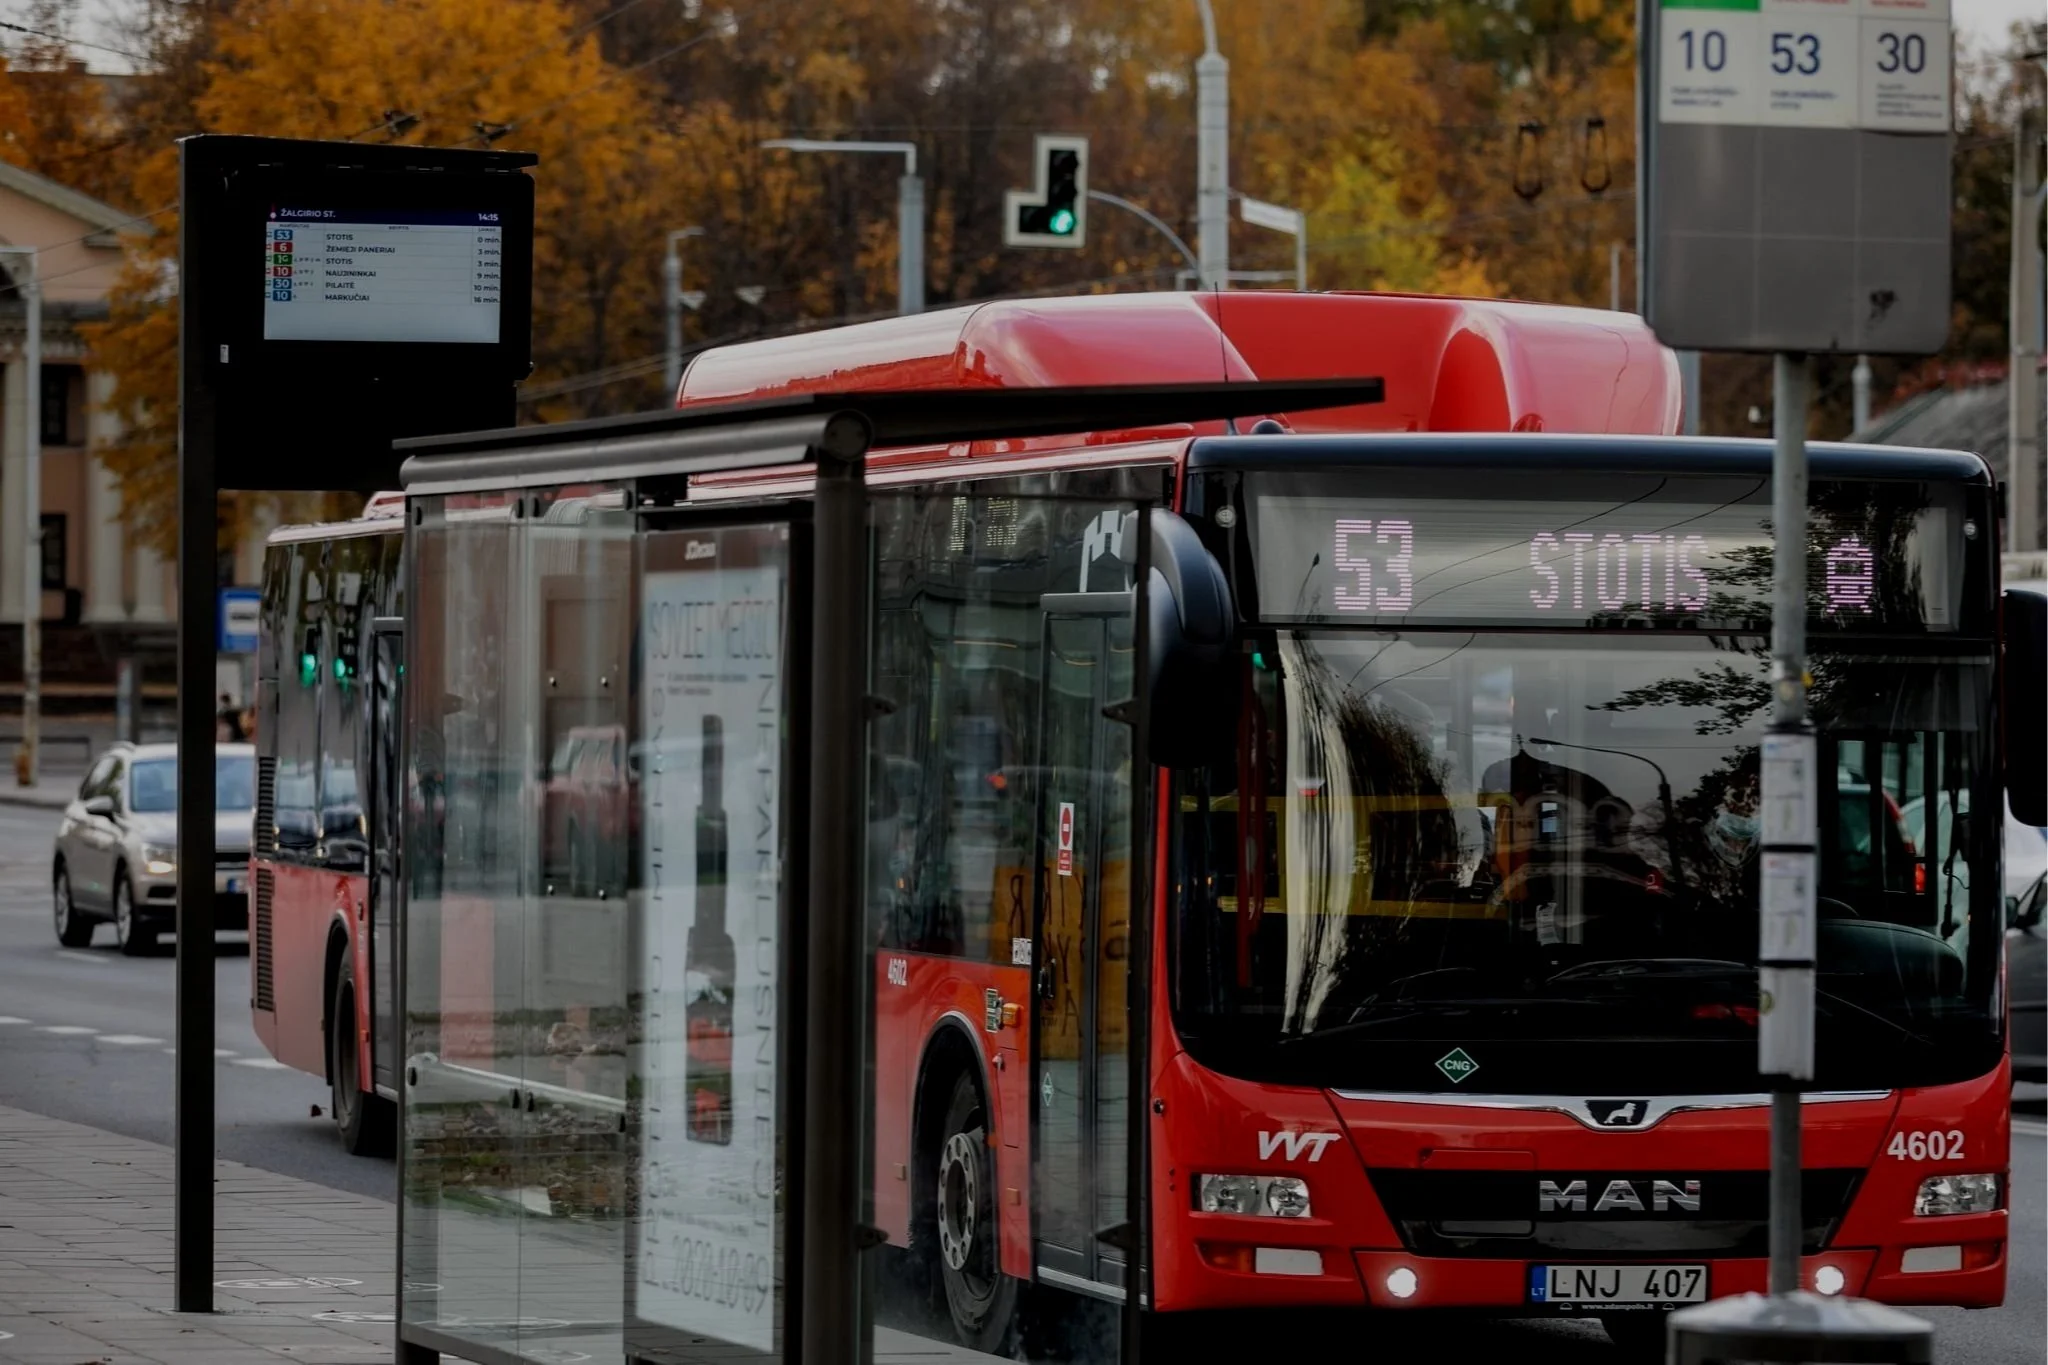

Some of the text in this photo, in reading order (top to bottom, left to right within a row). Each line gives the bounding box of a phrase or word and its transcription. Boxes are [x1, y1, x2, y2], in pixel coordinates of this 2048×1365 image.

[1679, 30, 1726, 71] 10
[1771, 33, 1821, 75] 53
[1877, 32, 1925, 73] 30
[280, 207, 337, 218] ŽALGIRIO ST.
[477, 212, 499, 221] 14:15
[276, 230, 292, 240] 53
[326, 233, 353, 241] STOTIS
[279, 243, 288, 252] 6
[325, 245, 356, 253] ŽEMIEJI
[277, 267, 289, 276] 10
[275, 279, 289, 288] 30
[276, 291, 289, 300] 10
[325, 293, 370, 301] MARKUČIAI
[1335, 519, 1709, 611] 53 STOTIS
[1444, 1060, 1471, 1071] CNG
[1887, 1130, 1965, 1161] 4602
[1539, 1180, 1701, 1211] MAN
[1531, 1269, 1701, 1298] LT LNJ 407
